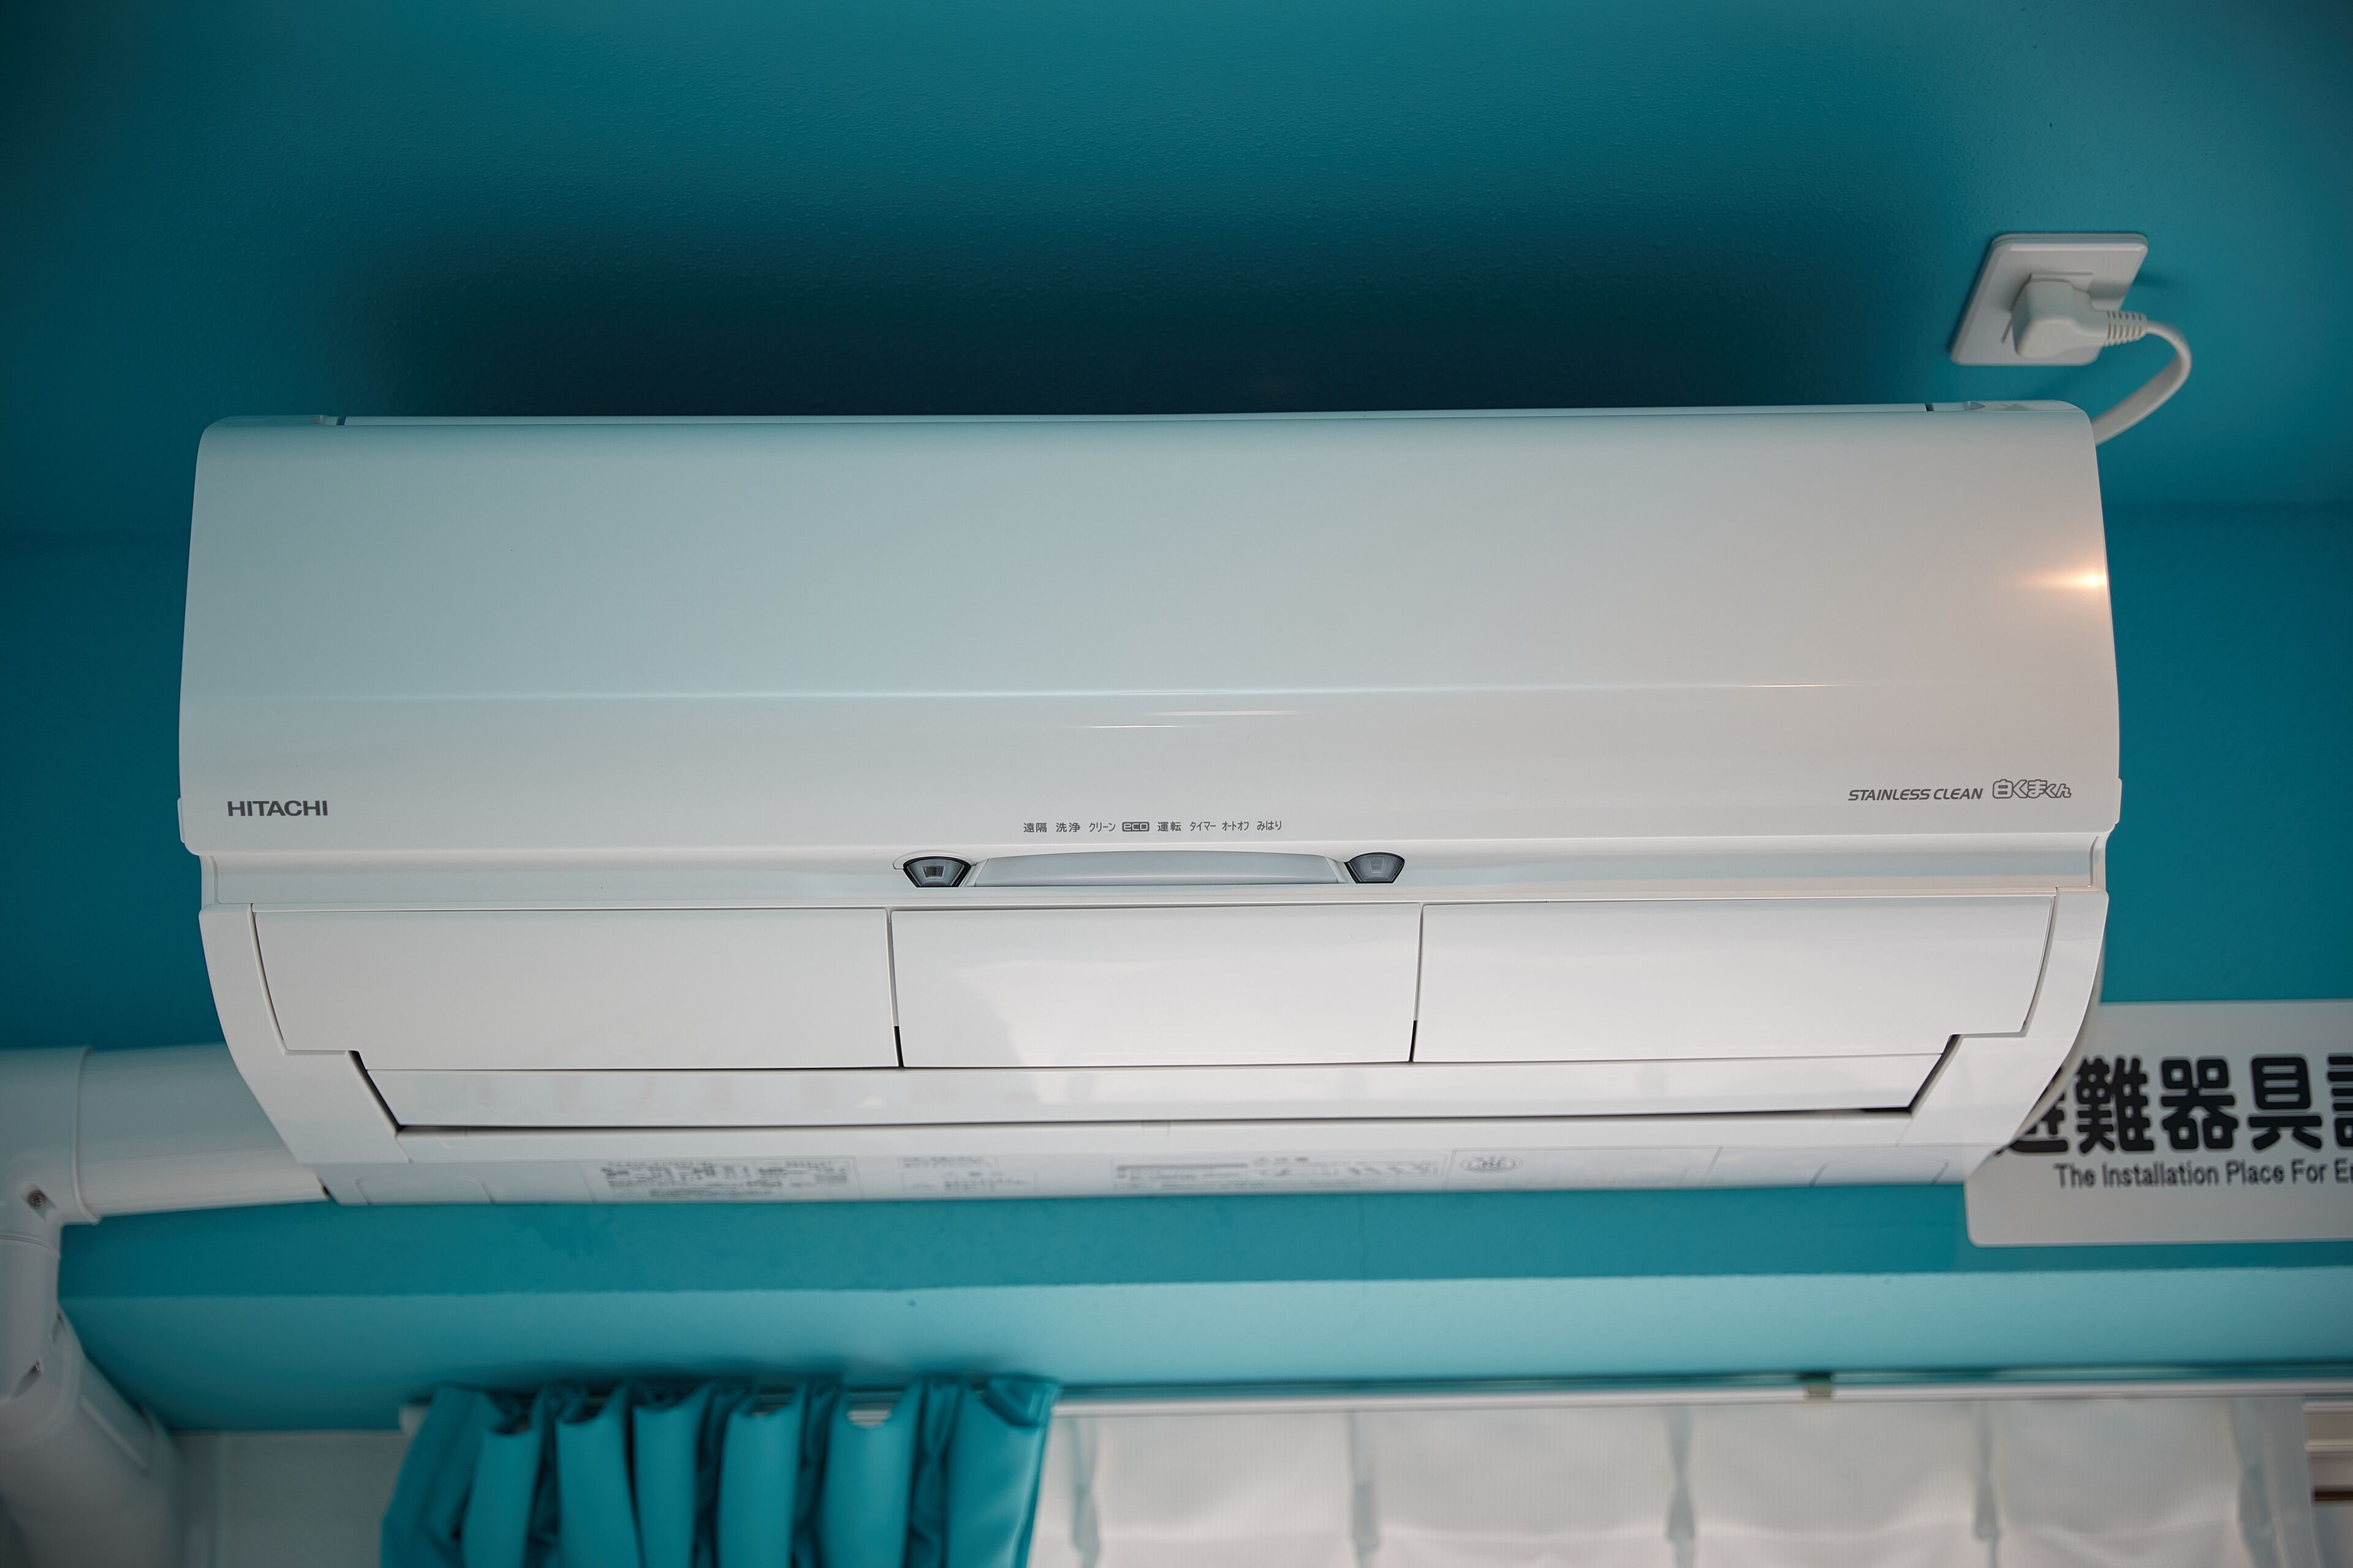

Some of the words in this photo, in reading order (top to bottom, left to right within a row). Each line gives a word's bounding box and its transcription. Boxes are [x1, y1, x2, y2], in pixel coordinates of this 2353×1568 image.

[1848, 789, 1931, 801] STAINLESS
[1933, 788, 1983, 800] CLEAN
[1992, 779, 2072, 798] 白くまくん
[227, 800, 328, 816] HITACHI
[1023, 822, 1047, 833] 遠隔
[1055, 822, 1081, 833] 洗浄
[1089, 822, 1116, 832] クリーン
[1122, 822, 1150, 832] eco
[1158, 821, 1181, 831] 運転
[1189, 821, 1216, 831] タイマー
[1257, 820, 1282, 830] みはり
[2054, 1162, 2096, 1188] The
[2102, 1161, 2219, 1188] Installation
[2226, 1158, 2284, 1186] Place
[2292, 1158, 2328, 1184] For
[2334, 1157, 2353, 1183] E
